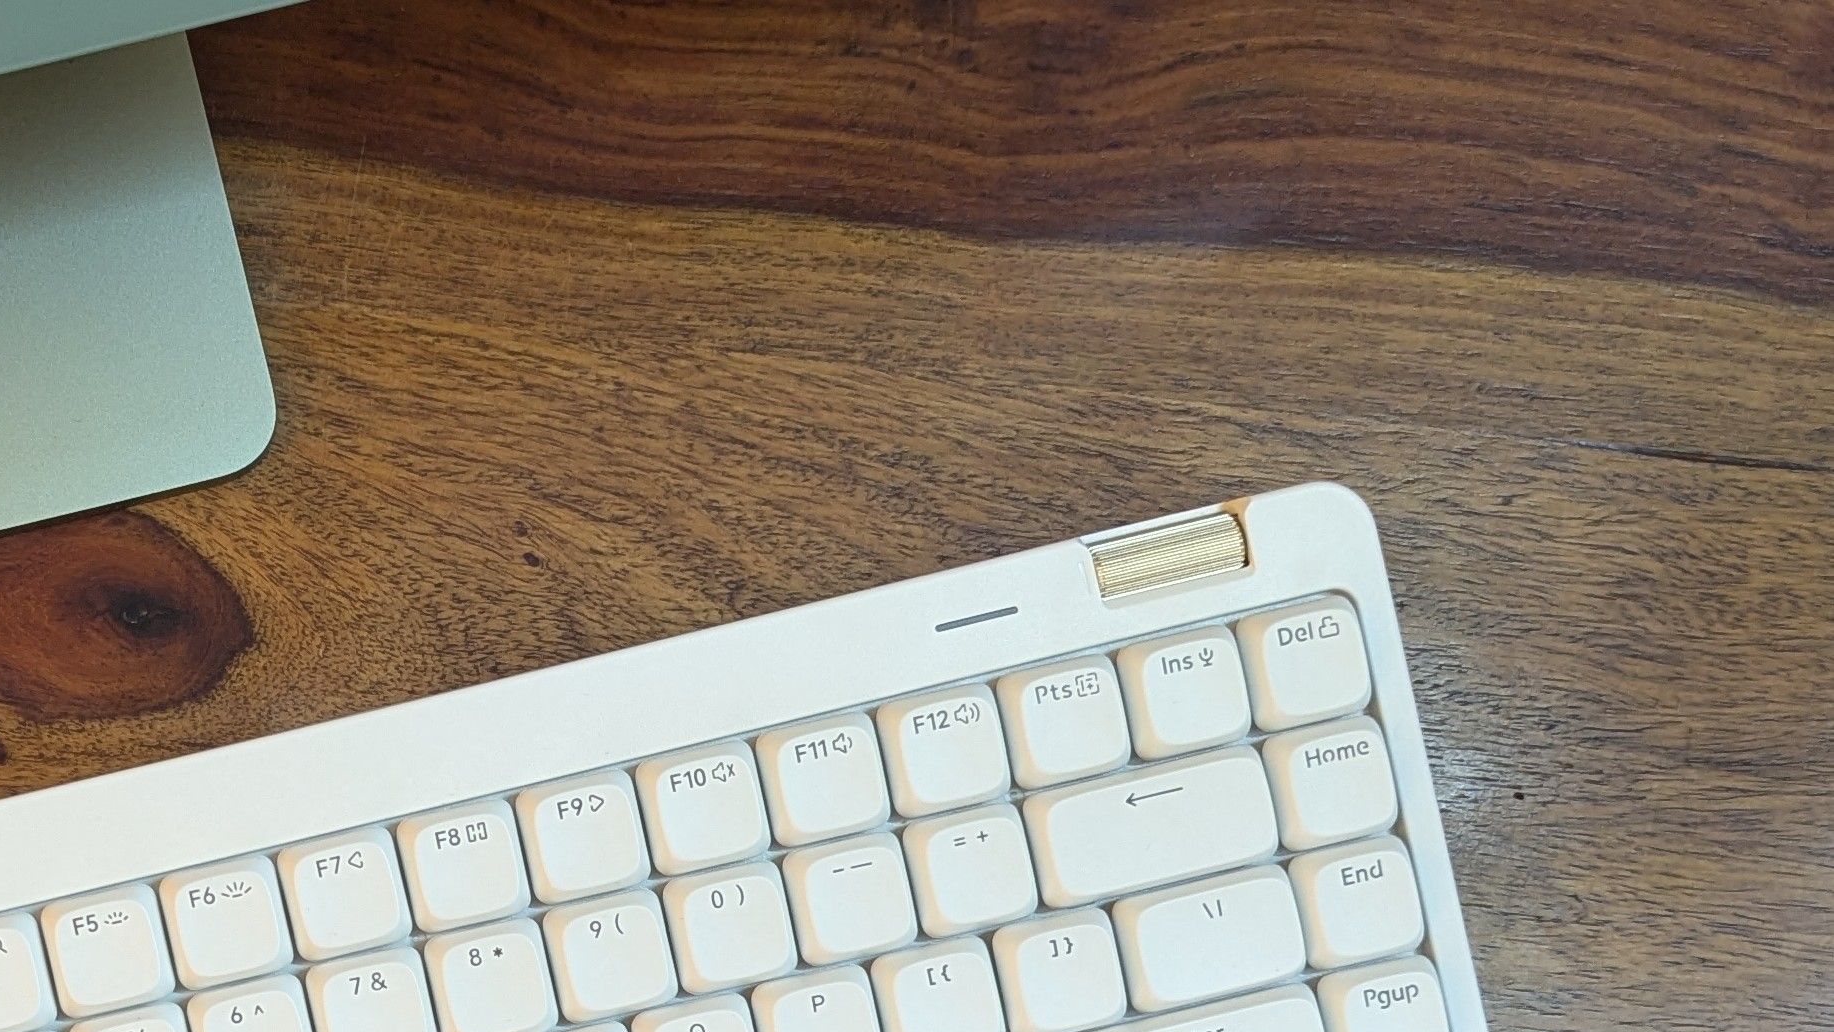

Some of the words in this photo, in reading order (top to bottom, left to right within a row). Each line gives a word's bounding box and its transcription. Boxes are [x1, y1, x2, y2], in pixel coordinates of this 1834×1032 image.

[1276, 621, 1315, 647] Del
[1161, 655, 1194, 676] Ins
[1034, 684, 1073, 705] Pts
[912, 709, 951, 735] F12
[794, 738, 829, 764] F11
[1304, 740, 1368, 769] Home
[669, 767, 707, 793] F10
[556, 797, 584, 821] F9
[434, 827, 462, 850] F8
[315, 854, 341, 879] F7
[1340, 858, 1384, 887] End
[188, 886, 217, 909] F6
[710, 889, 725, 910] 0
[71, 913, 100, 937] F5
[589, 920, 603, 939] 9
[468, 947, 483, 967] 8
[348, 976, 361, 996] 7
[370, 971, 388, 992] &
[810, 994, 826, 1014] P
[1362, 983, 1420, 1010] Pgup
[230, 1005, 244, 1025] 6
